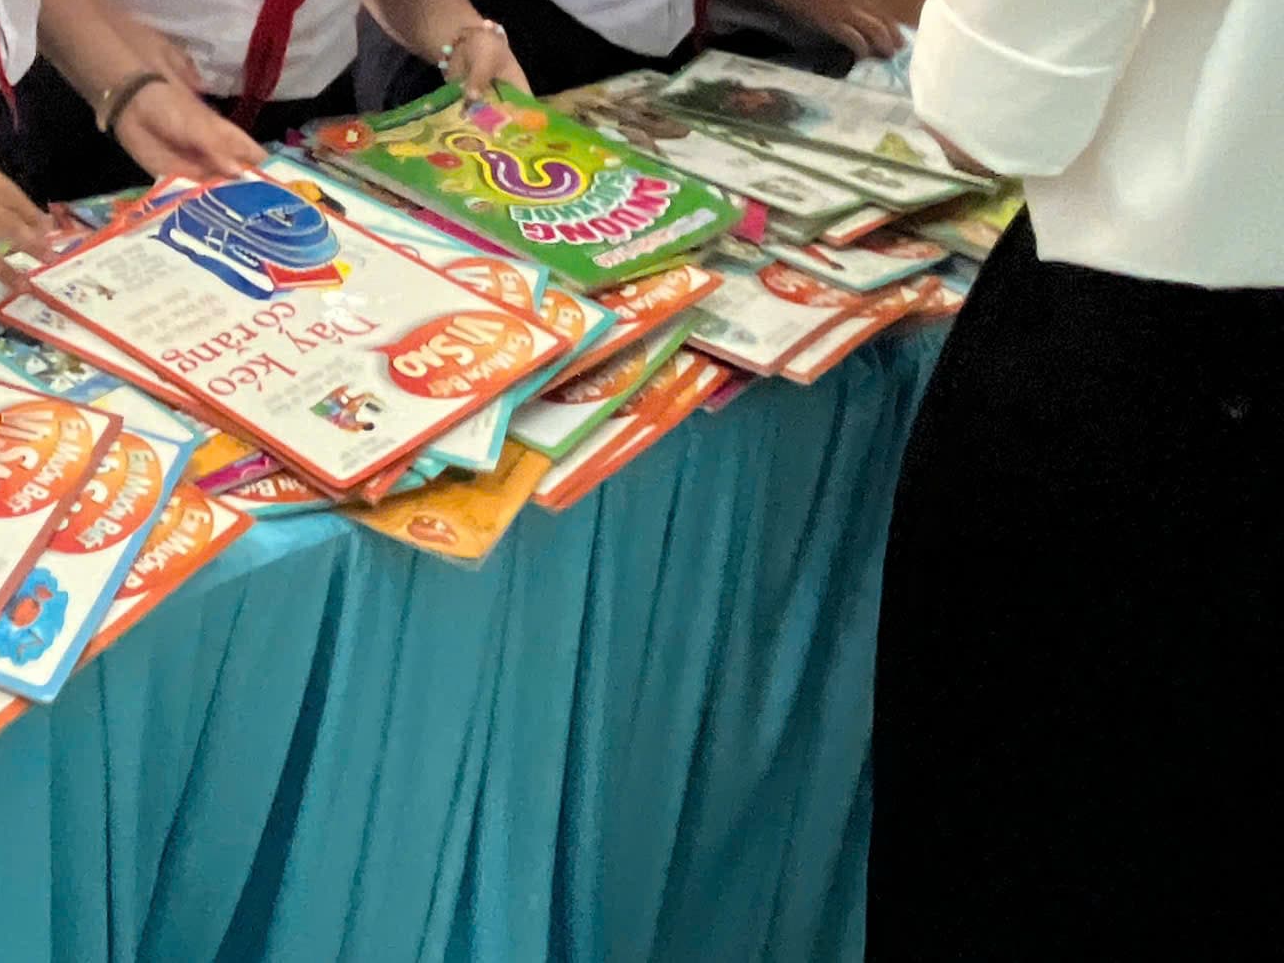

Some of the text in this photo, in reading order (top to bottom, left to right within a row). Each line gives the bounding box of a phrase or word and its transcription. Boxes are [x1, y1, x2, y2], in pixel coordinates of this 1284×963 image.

[252, 301, 297, 336] có
[161, 327, 257, 372] răng
[393, 335, 475, 378] SAO
[207, 348, 298, 398] kéo
